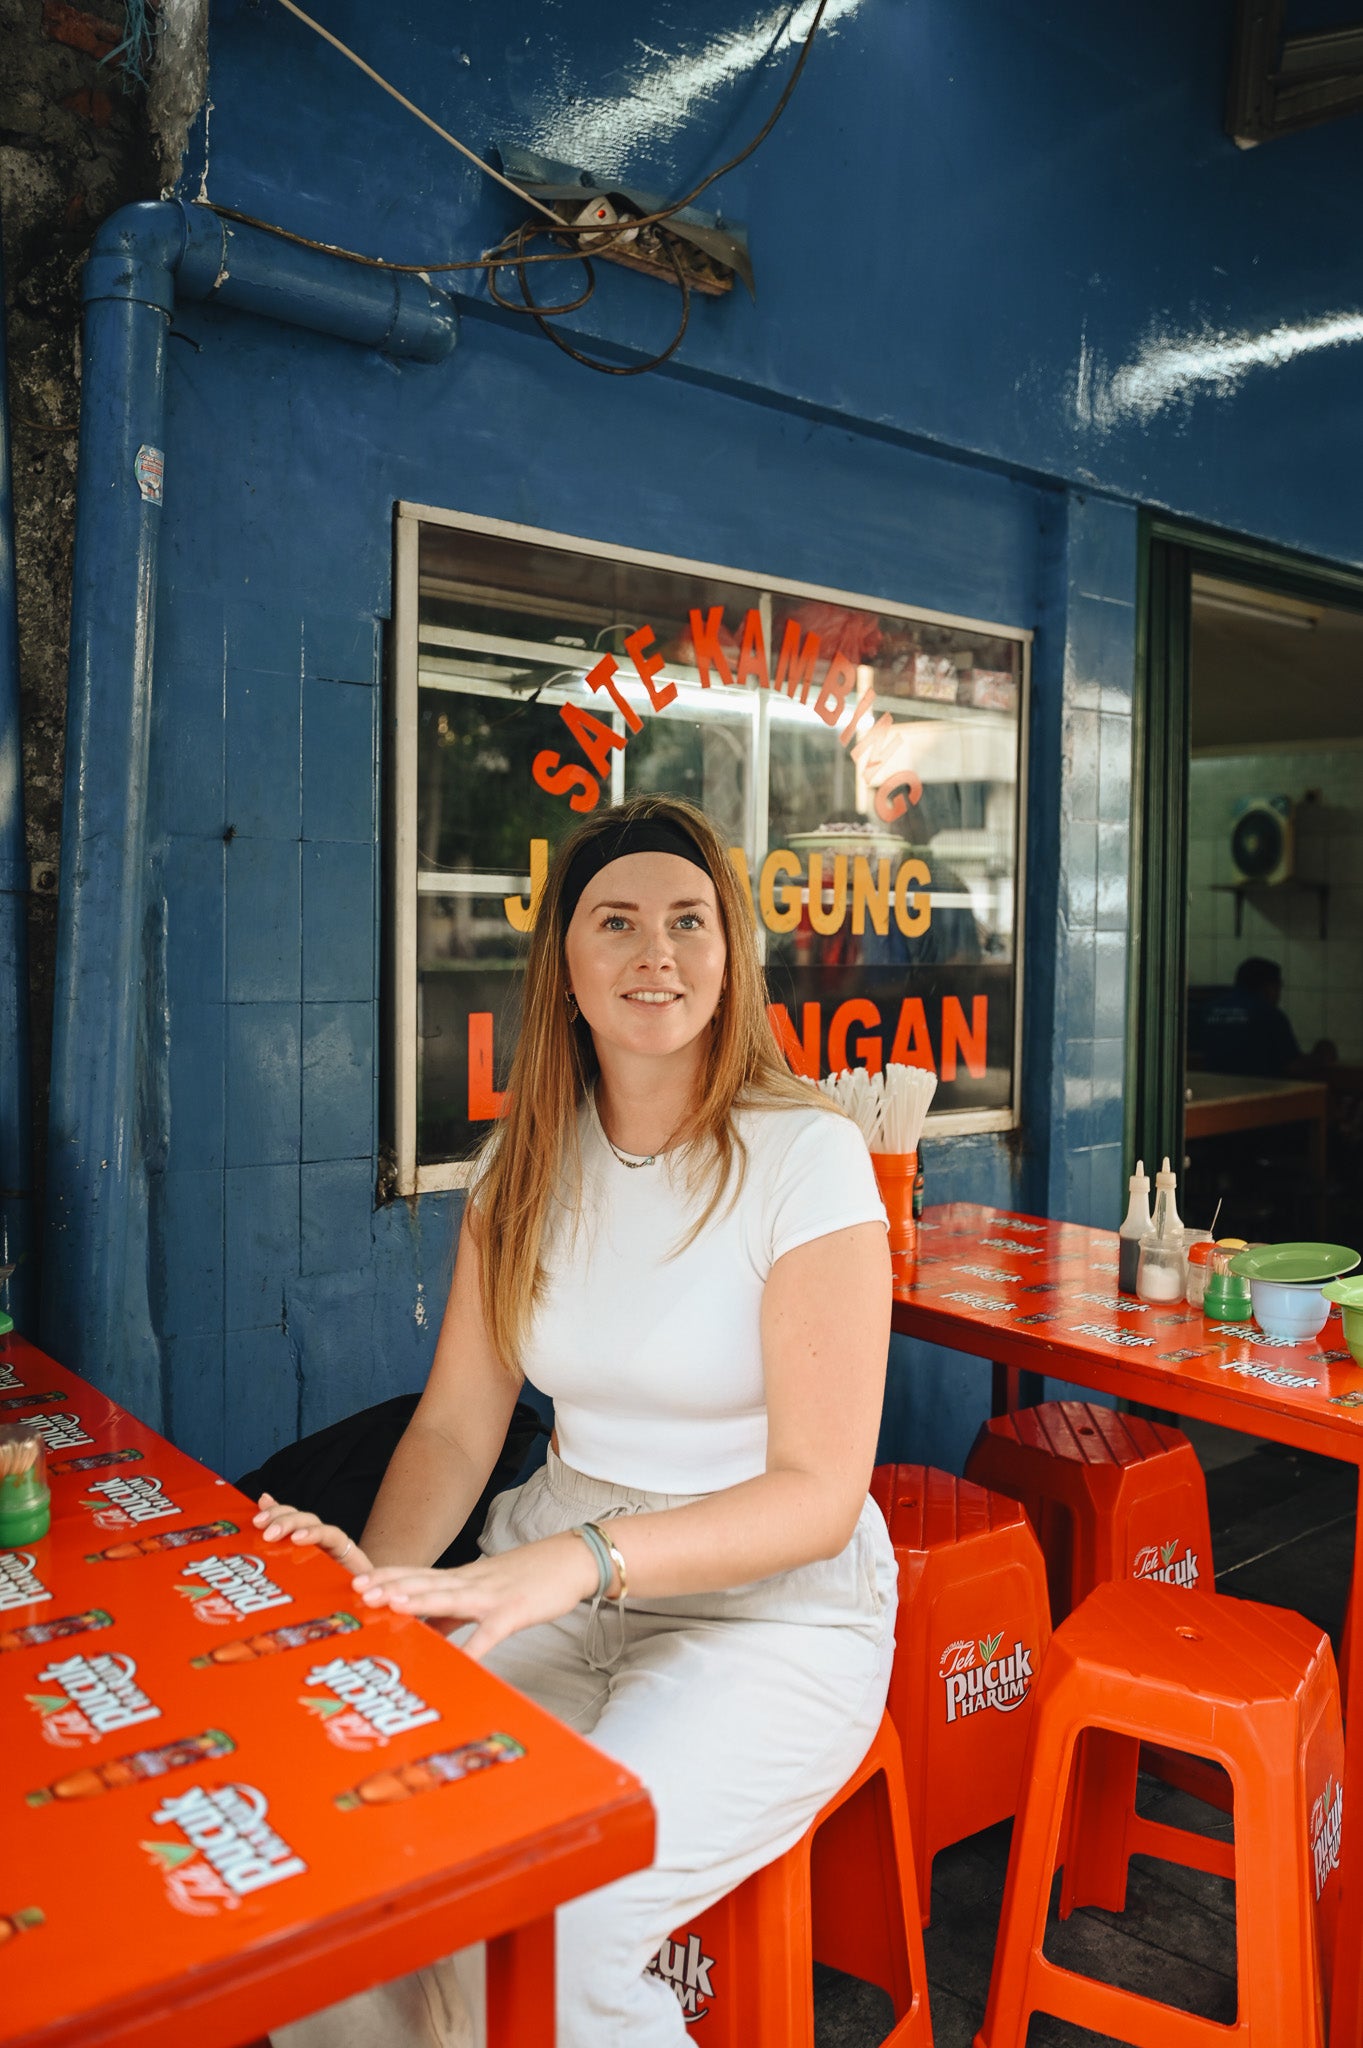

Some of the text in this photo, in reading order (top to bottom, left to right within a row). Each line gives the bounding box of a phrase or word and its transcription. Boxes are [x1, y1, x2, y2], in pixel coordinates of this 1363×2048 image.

[532, 606, 923, 823] SATE KAMBING
[939, 1640, 977, 1678] Teh
[961, 1679, 1031, 1716] HARUM
